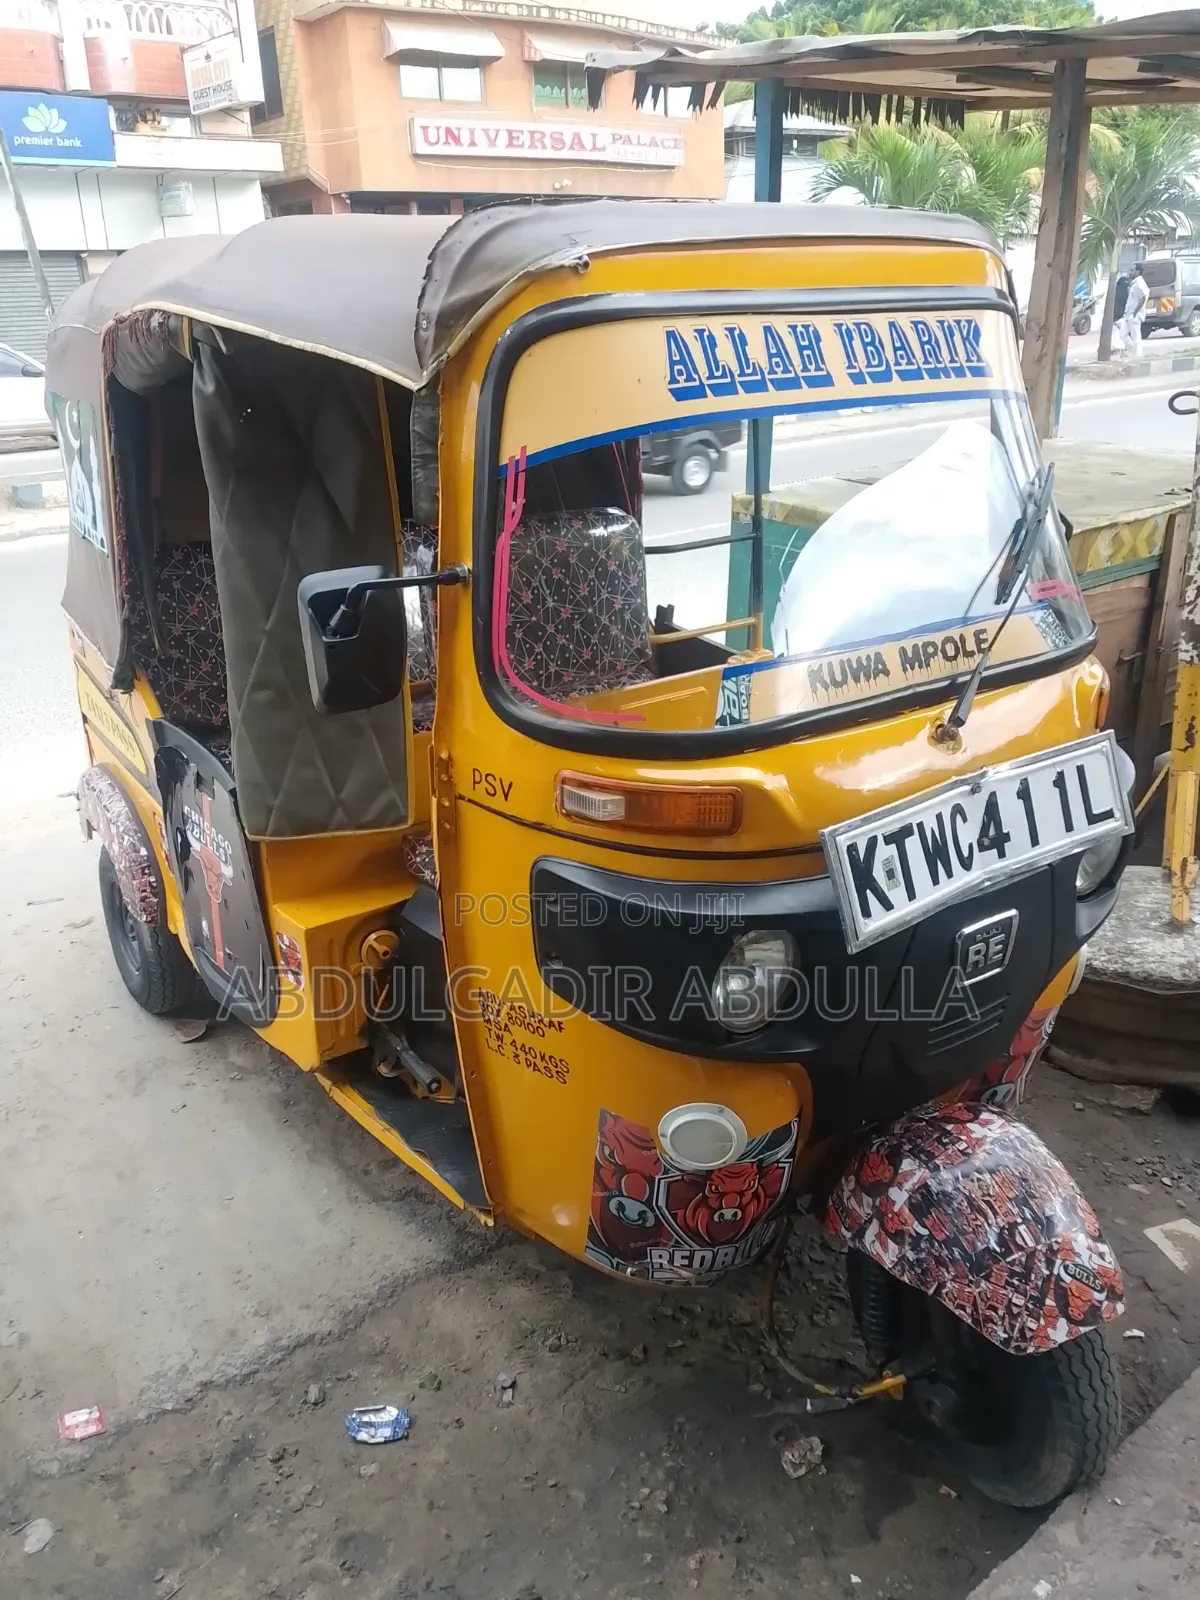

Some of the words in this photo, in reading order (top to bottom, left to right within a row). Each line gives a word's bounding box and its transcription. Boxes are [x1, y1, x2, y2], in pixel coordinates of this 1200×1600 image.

[193, 86, 211, 100] GUEST
[212, 80, 233, 96] HOUSE
[14, 136, 54, 147] premier
[57, 136, 83, 148] bank
[420, 125, 606, 151] UNIVERSAL
[610, 132, 683, 149] PALACE
[662, 321, 835, 402] ALLAH
[830, 316, 994, 384] IBARIK
[807, 650, 891, 702] KUWA
[899, 627, 989, 682] MPOLE
[472, 767, 513, 801] PSV
[184, 805, 233, 855] CHICAGO
[192, 822, 226, 862] BULLS
[965, 933, 1006, 974] RE
[512, 1050, 521, 1065] 3
[525, 1057, 568, 1085] PASS
[1067, 1263, 1102, 1291] BULLS
